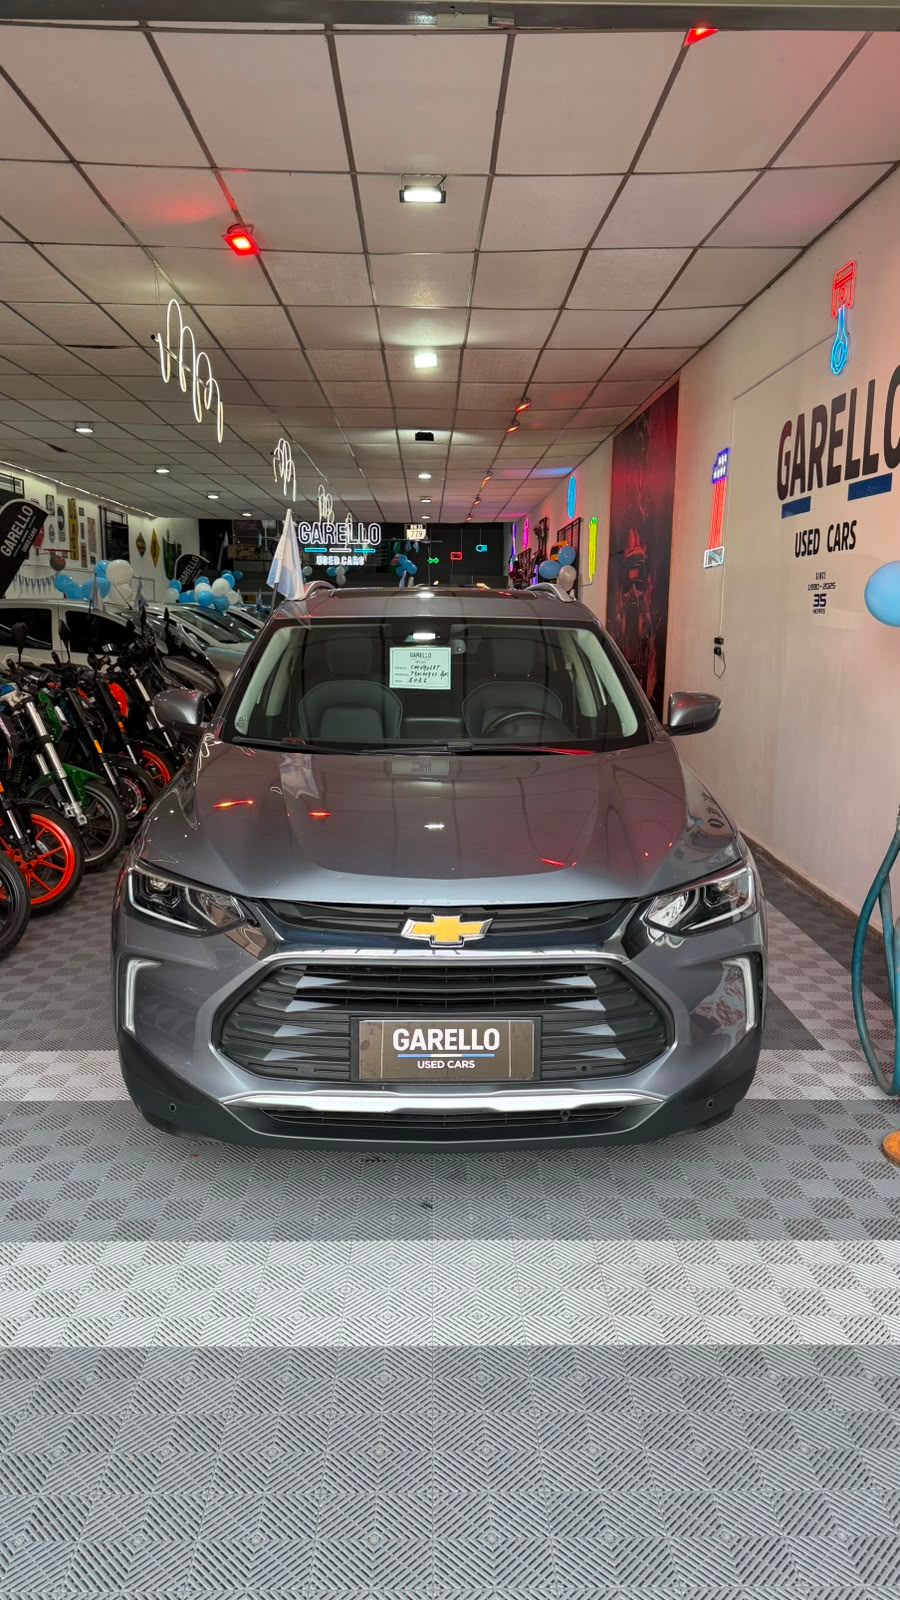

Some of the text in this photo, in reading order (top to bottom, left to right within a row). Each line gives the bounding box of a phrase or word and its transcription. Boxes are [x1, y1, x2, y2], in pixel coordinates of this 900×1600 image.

[0, 505, 34, 557] GARELLO
[298, 521, 382, 546] GARELLO
[795, 519, 857, 558] USED CARS
[813, 593, 827, 607] 35
[392, 1028, 500, 1051] GARELLO
[417, 1060, 475, 1069] USED CARS
